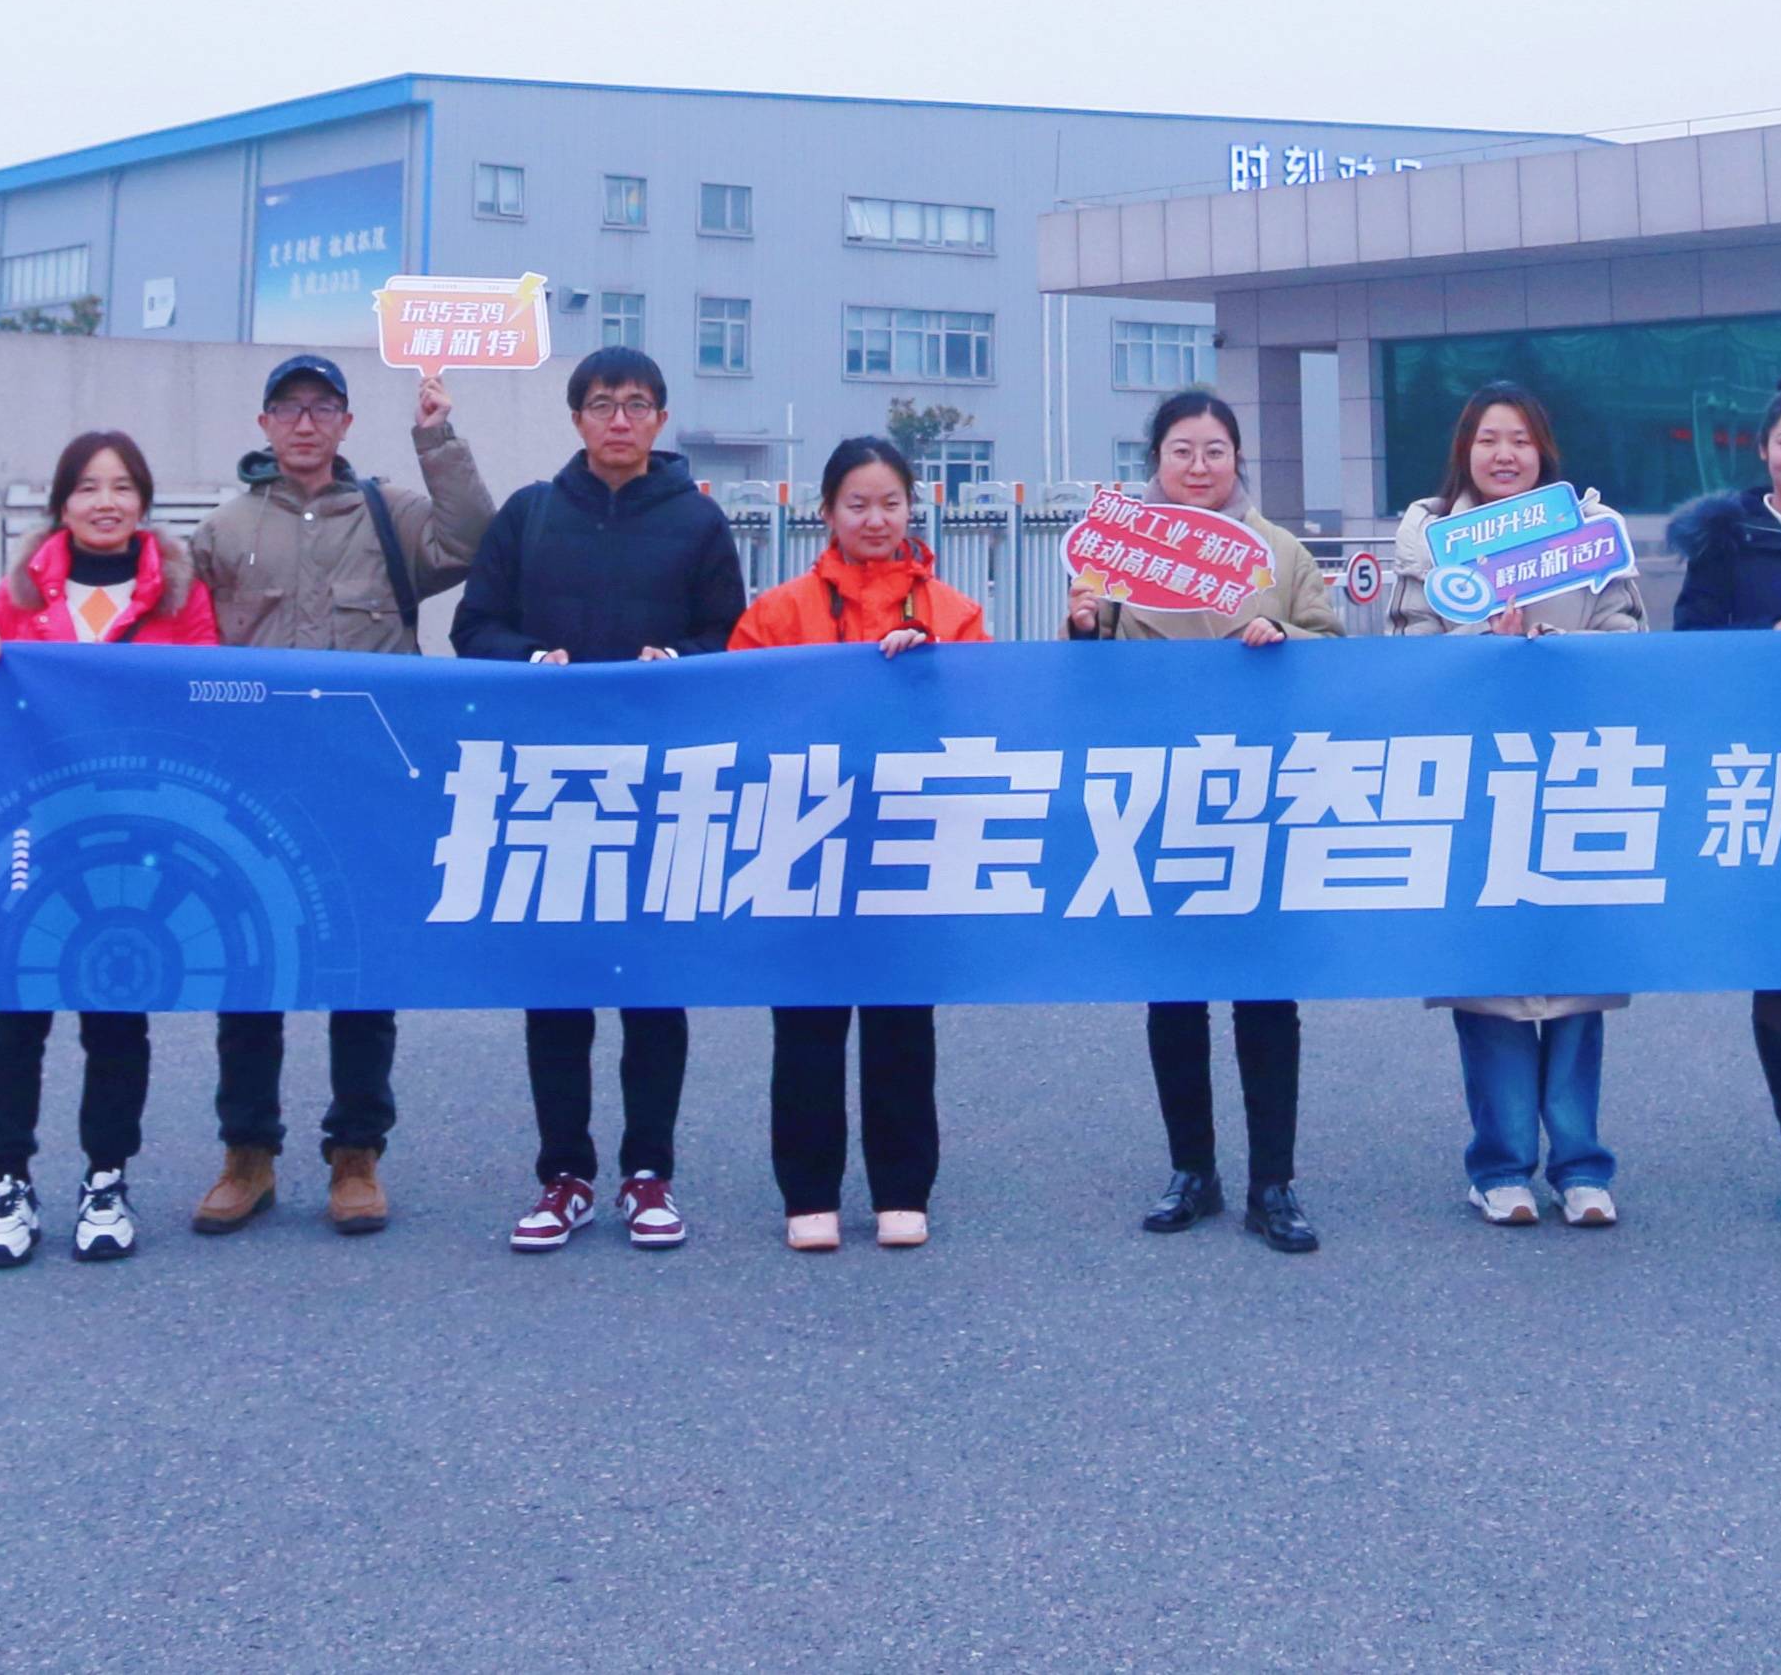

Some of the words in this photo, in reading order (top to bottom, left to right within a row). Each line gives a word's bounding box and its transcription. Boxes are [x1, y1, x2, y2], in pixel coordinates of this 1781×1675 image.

[400, 300, 506, 324] 玩转宝鸡
[1445, 502, 1548, 555] 产业升级
[1070, 526, 1247, 613] 推动高质量发展
[1358, 565, 1373, 592] 5
[1494, 536, 1616, 589] 释放新活力
[426, 726, 1668, 924] 探秘宝鸡智造
